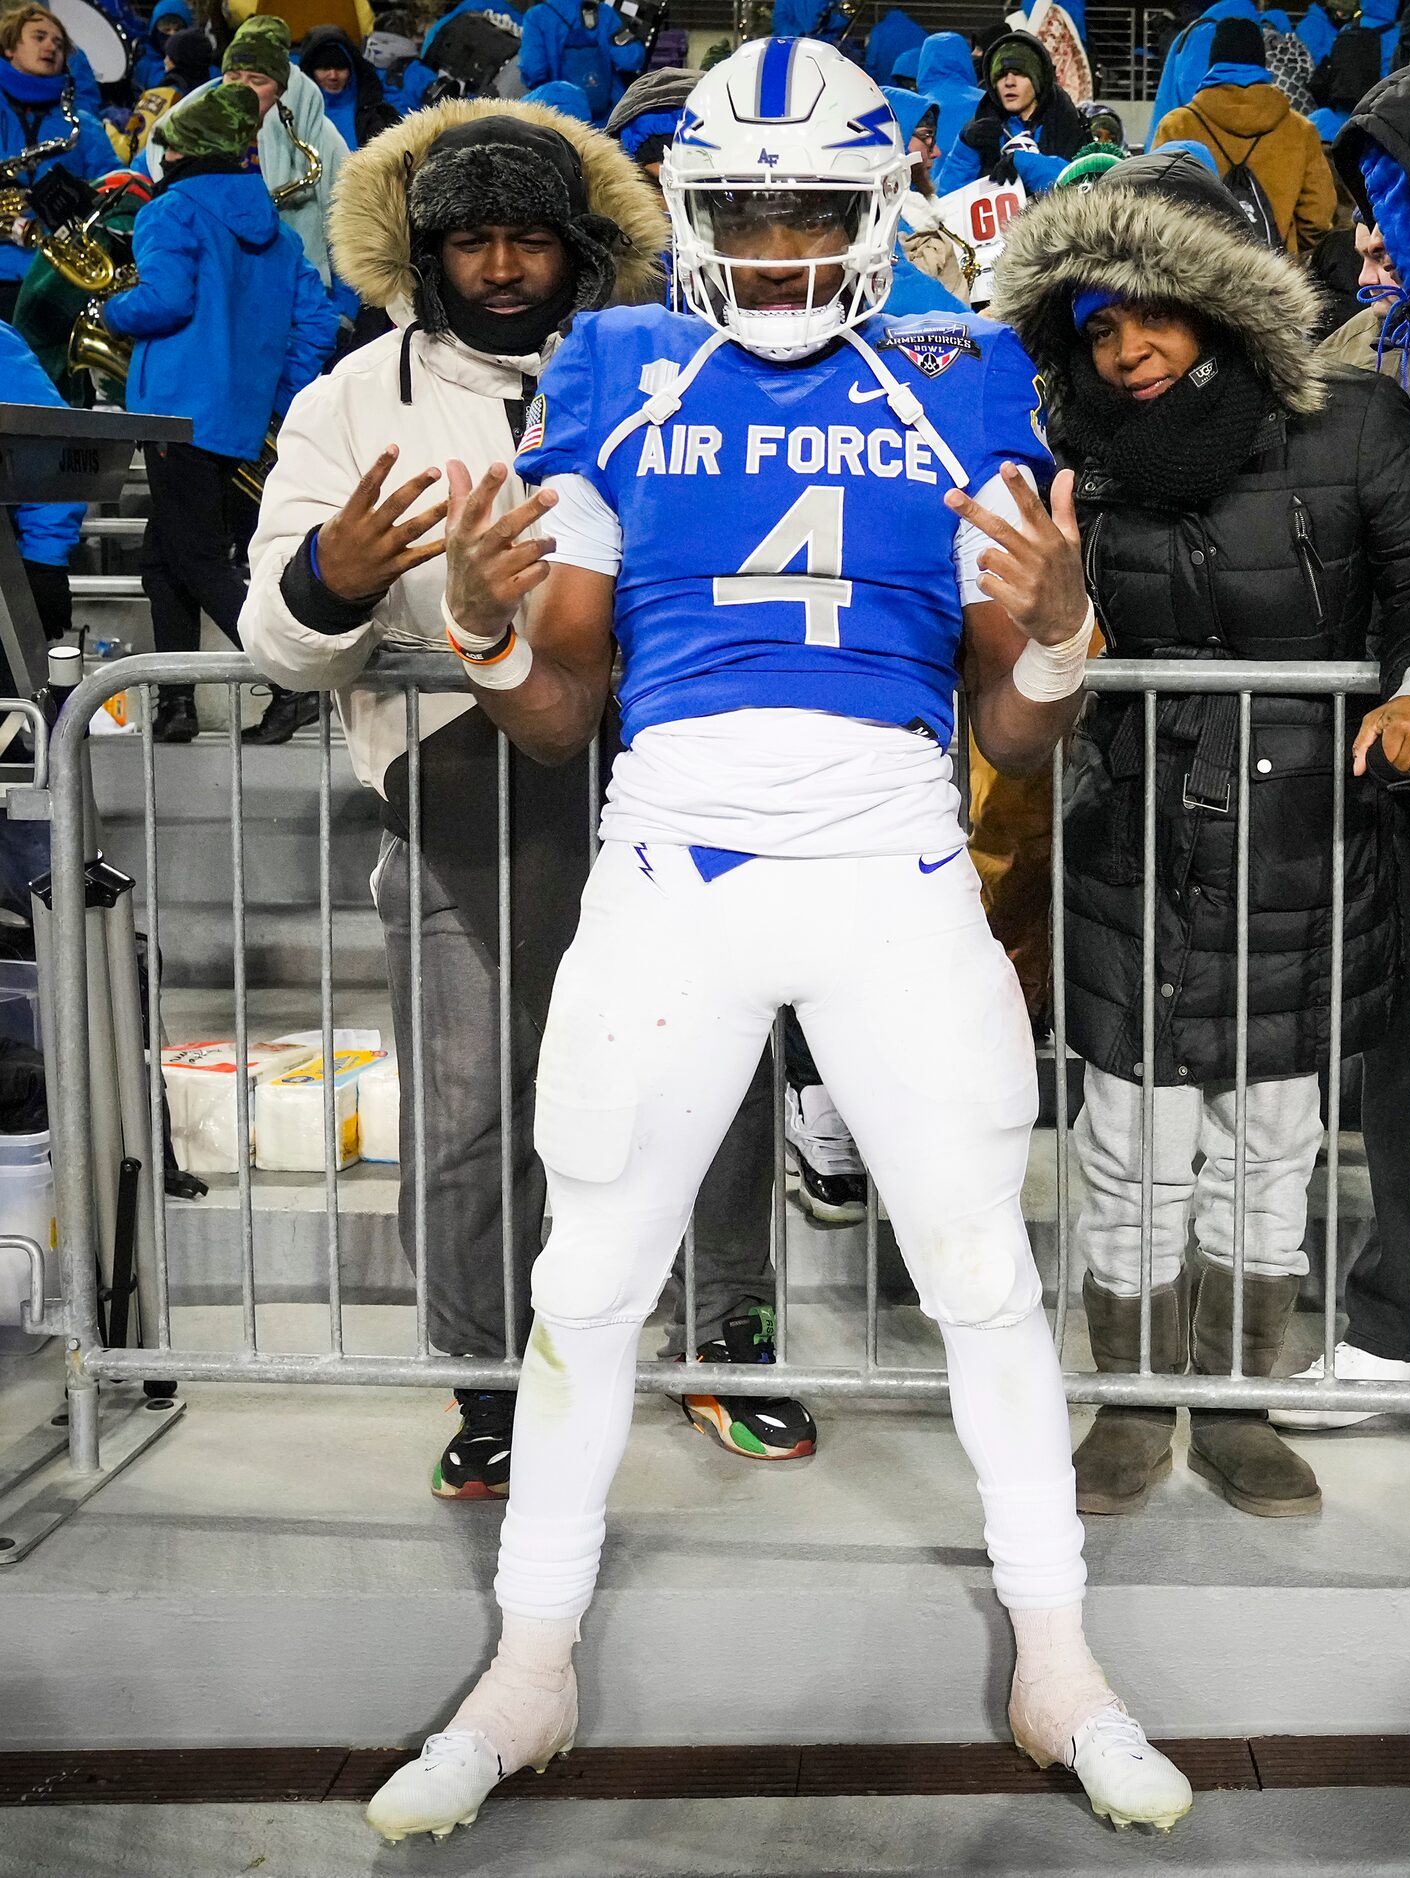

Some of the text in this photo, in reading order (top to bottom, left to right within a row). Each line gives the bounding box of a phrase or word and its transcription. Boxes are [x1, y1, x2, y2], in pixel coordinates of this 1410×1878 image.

[886, 335, 972, 349] ARMED FORCES
[914, 345, 945, 354] BOWL
[58, 448, 100, 474] JARVIS
[637, 425, 938, 485] AIR FORCE
[713, 485, 853, 649] 4
